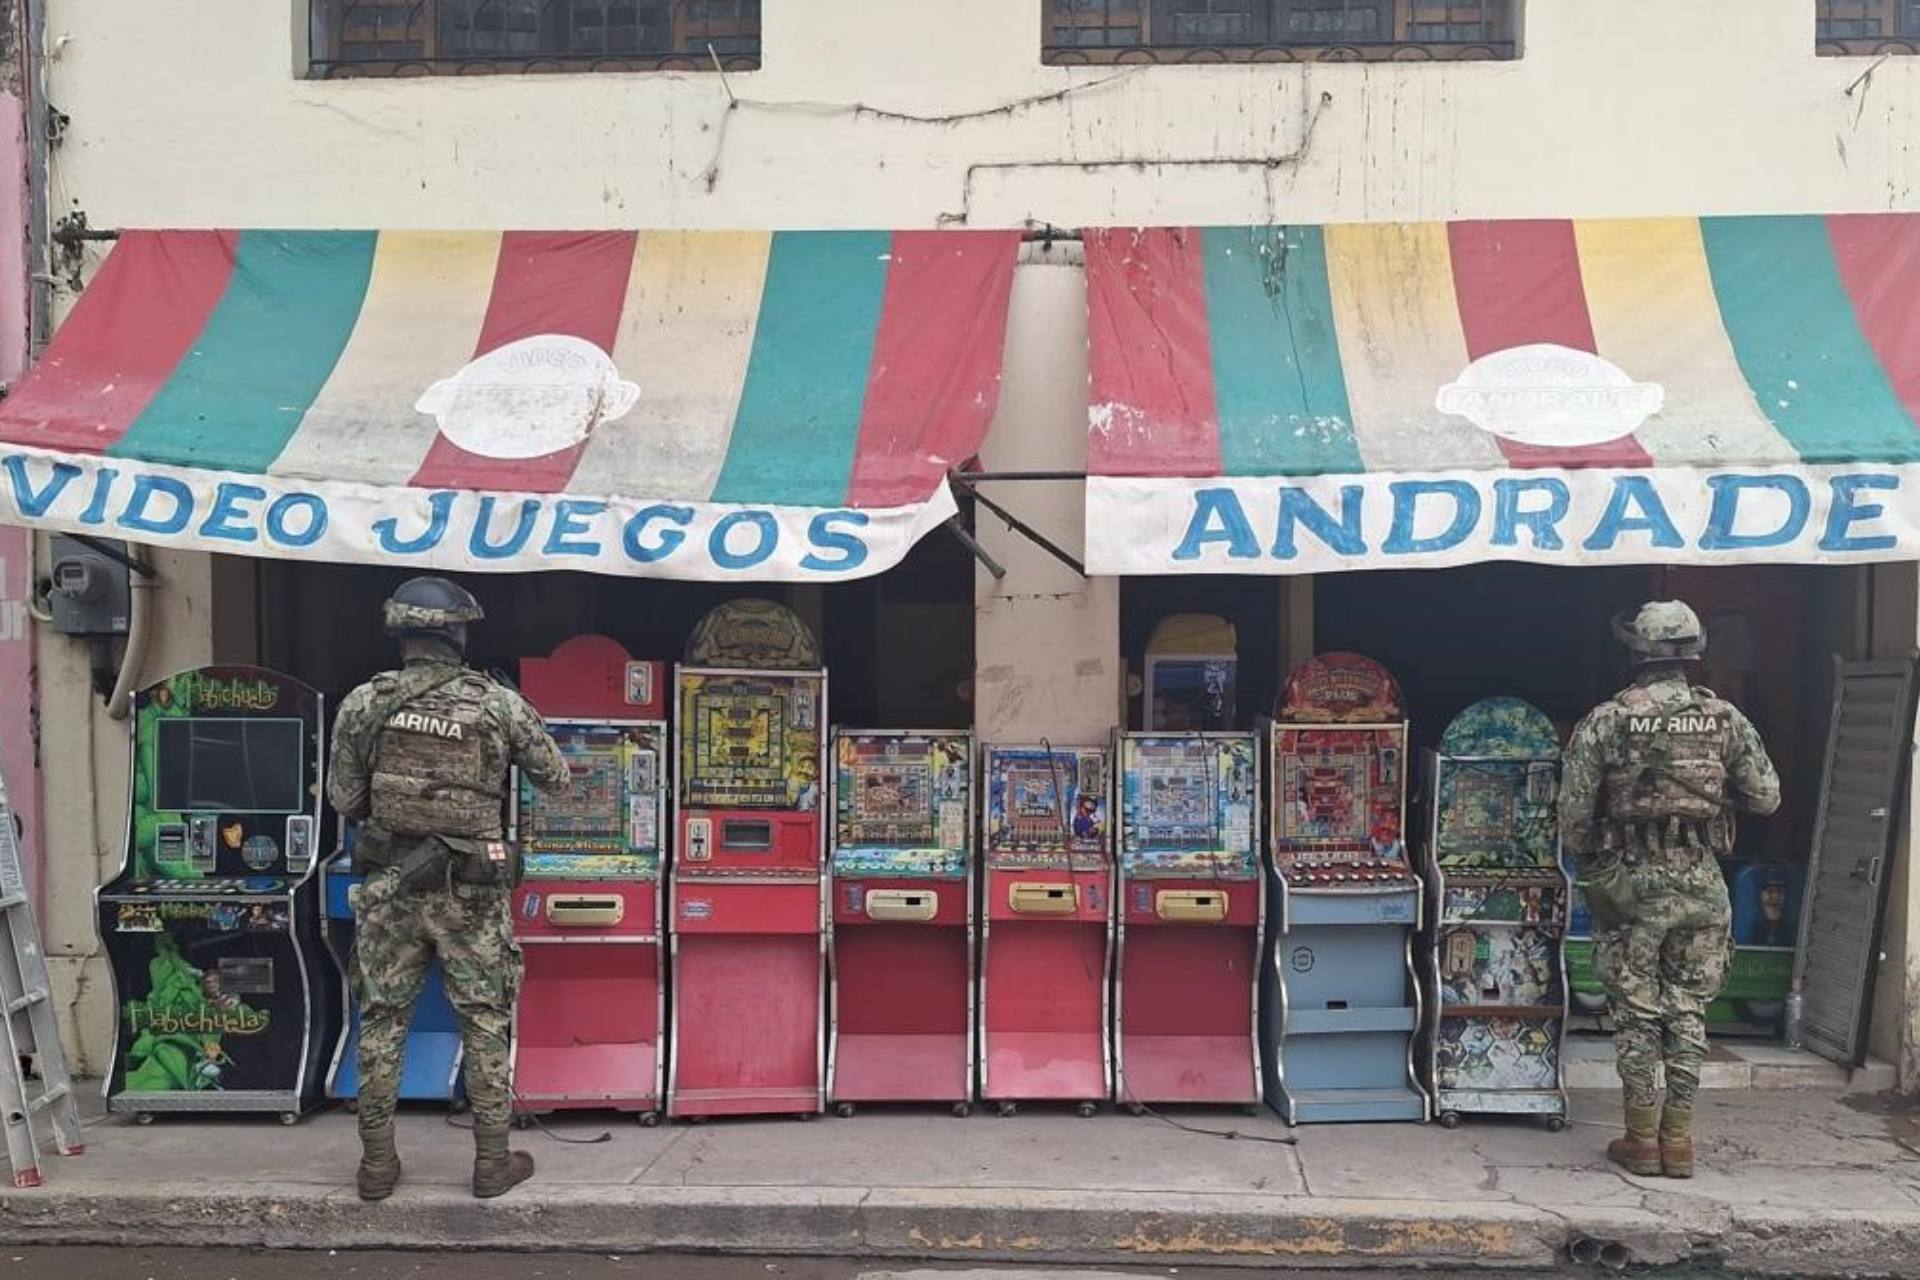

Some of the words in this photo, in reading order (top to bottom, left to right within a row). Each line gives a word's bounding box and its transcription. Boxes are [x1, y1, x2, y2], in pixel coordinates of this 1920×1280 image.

[1, 454, 329, 548] VIDEO
[372, 490, 870, 572] JUEGOS
[1170, 473, 1900, 561] ANDRADE
